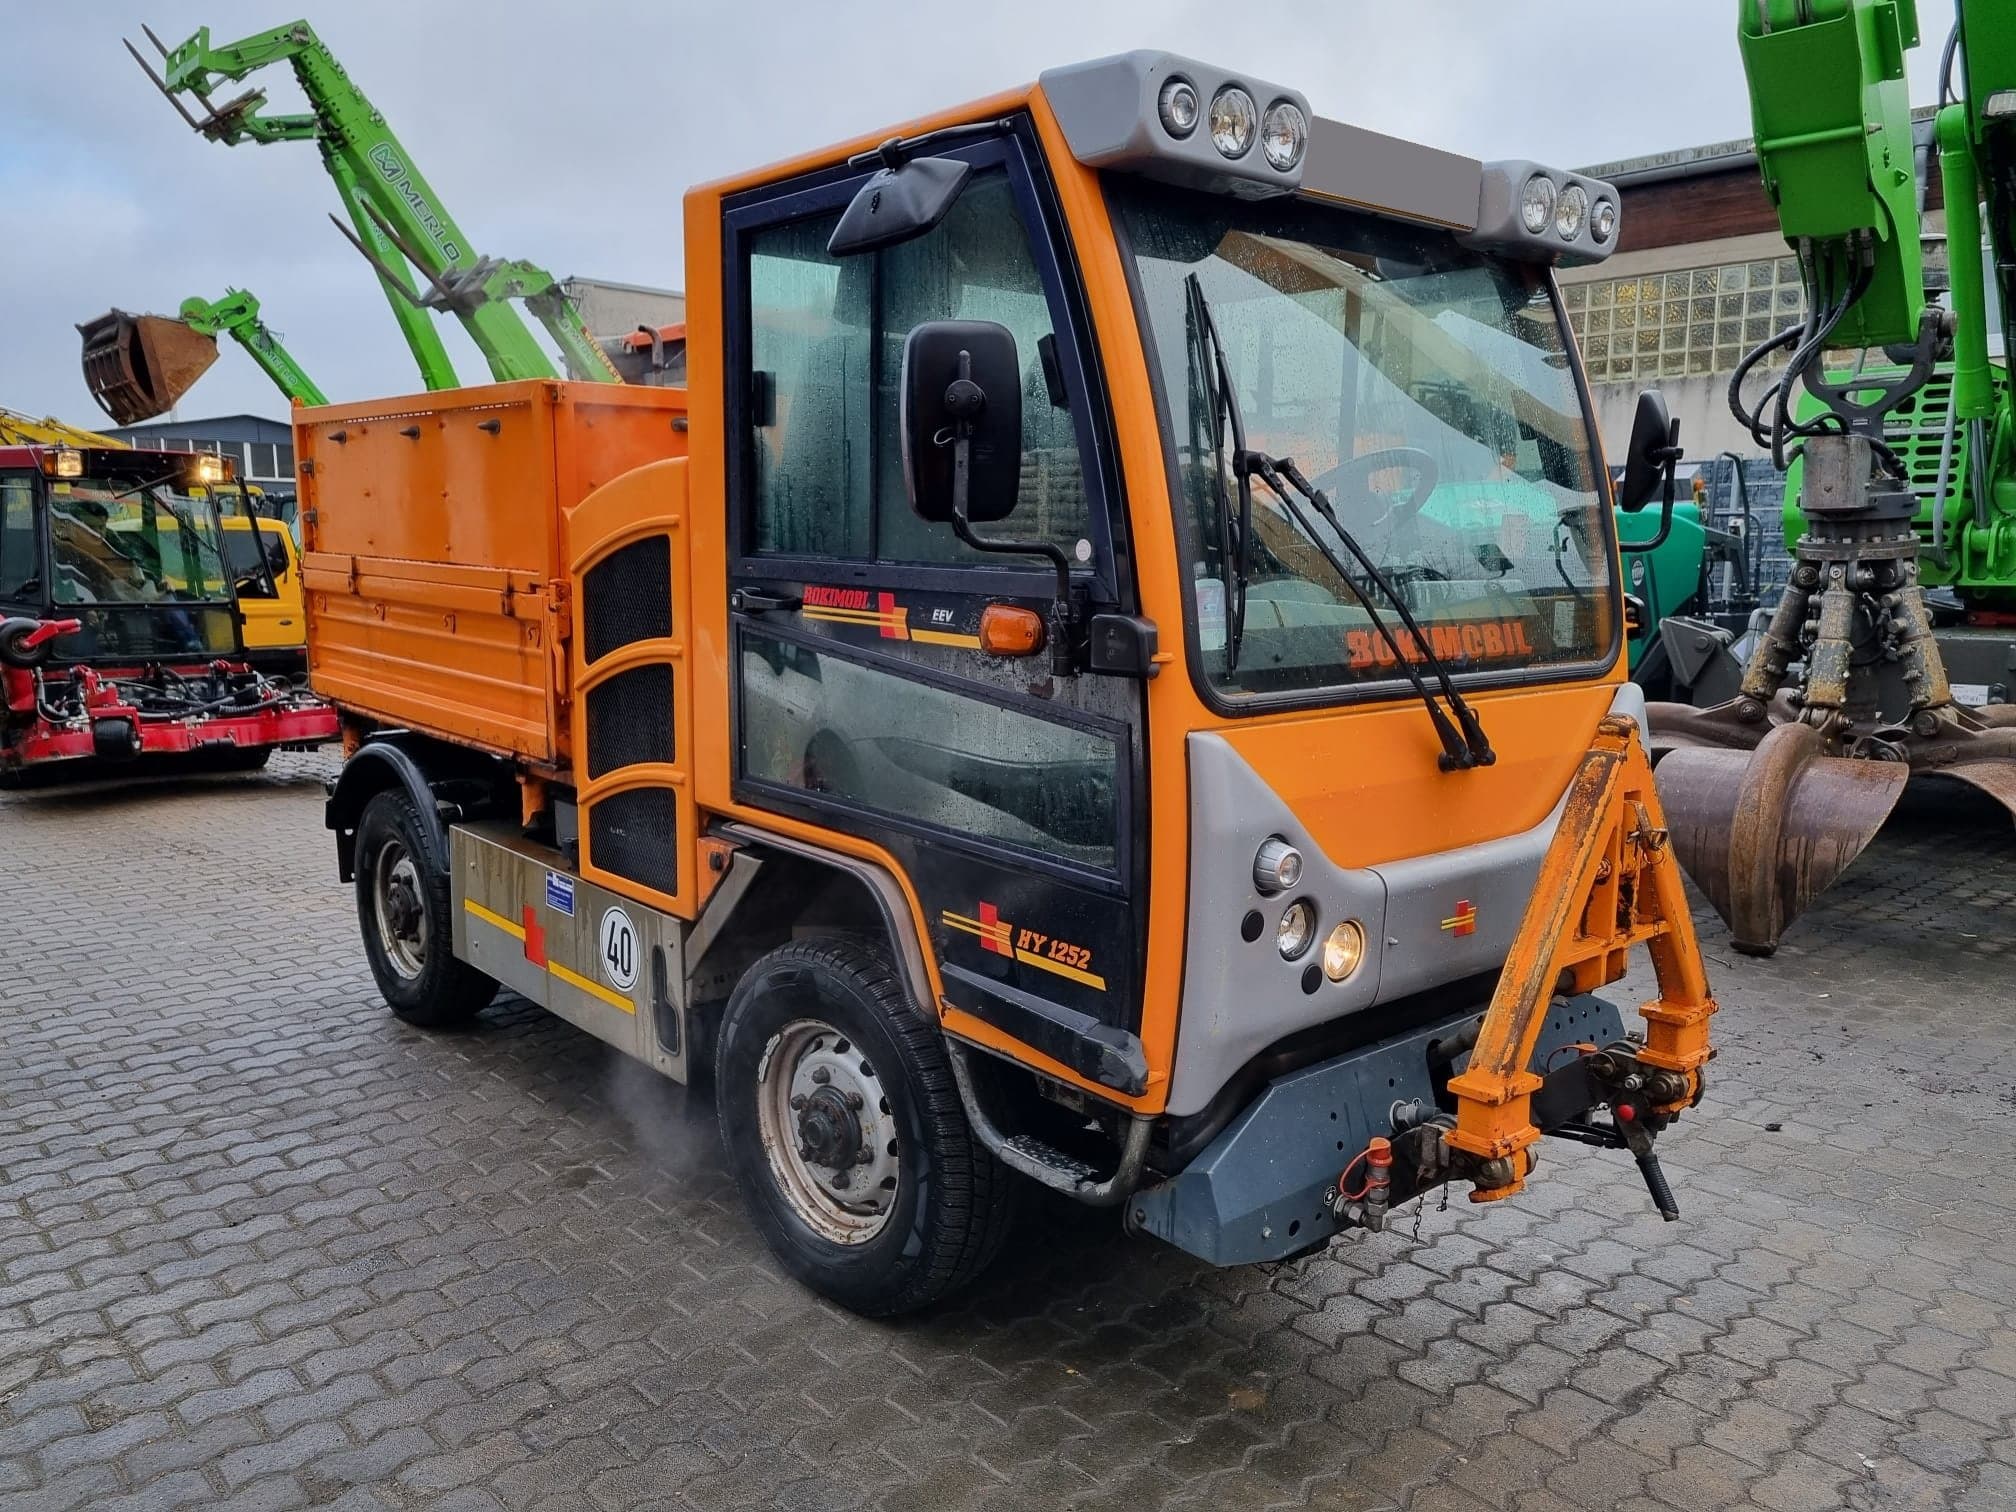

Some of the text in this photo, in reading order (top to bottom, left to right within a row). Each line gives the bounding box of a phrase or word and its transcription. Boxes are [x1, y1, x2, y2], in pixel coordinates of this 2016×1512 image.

[399, 180, 460, 261] MERLO
[932, 608, 954, 622] EEV
[607, 921, 631, 977] 40
[1017, 929, 1091, 969] HY 1252
